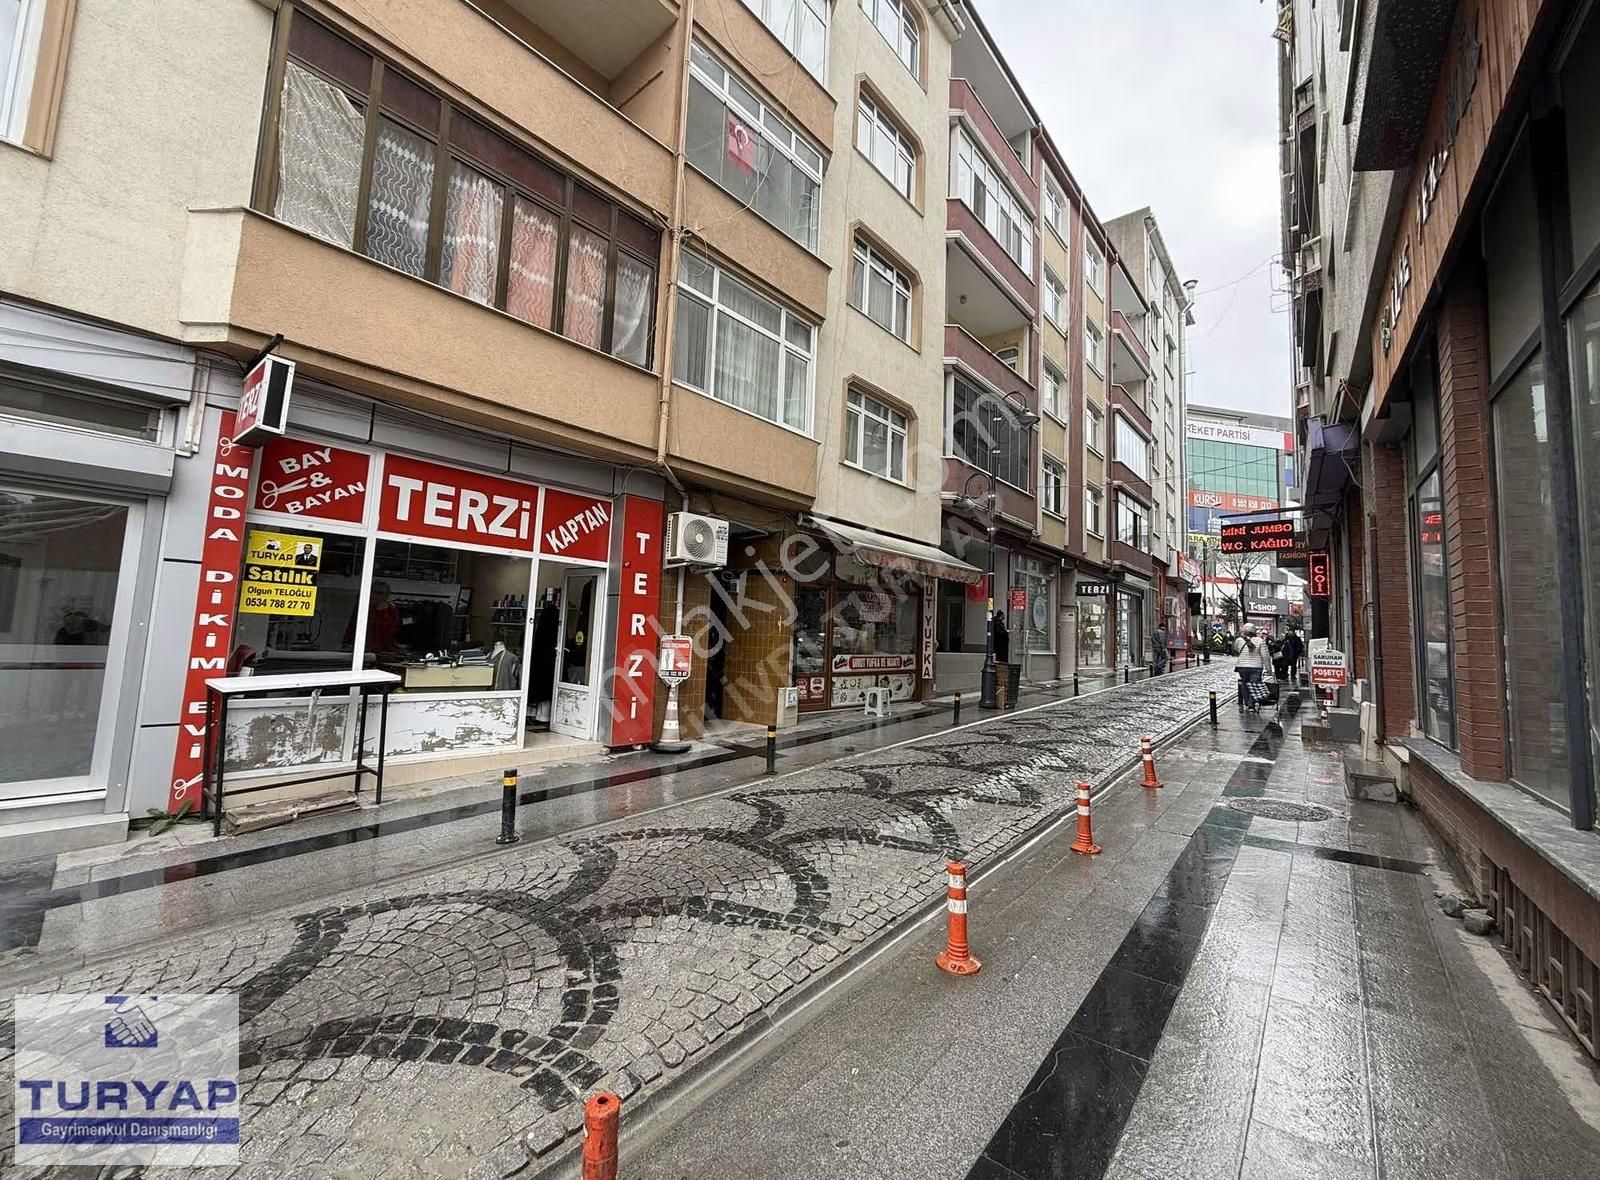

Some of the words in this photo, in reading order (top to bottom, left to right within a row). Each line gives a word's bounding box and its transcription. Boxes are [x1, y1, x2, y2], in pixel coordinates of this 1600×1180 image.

[279, 448, 332, 475] BAY
[309, 471, 333, 488] &
[208, 463, 249, 542] MODA
[285, 481, 366, 514] BAYAN
[1193, 492, 1222, 505] KURSU
[545, 502, 609, 553] KAPTAN
[1250, 524, 1292, 534] JUMBO
[1250, 537, 1293, 549] KAĞIDI
[250, 550, 293, 562] TURYAP
[248, 566, 314, 585] Satılık
[247, 586, 272, 596] Olgun
[274, 588, 312, 598] TELOĞLU
[245, 597, 267, 607] 0534
[270, 599, 285, 609] 788
[287, 601, 298, 610] 27
[300, 602, 310, 610] 70
[923, 615, 933, 678] YUFKA
